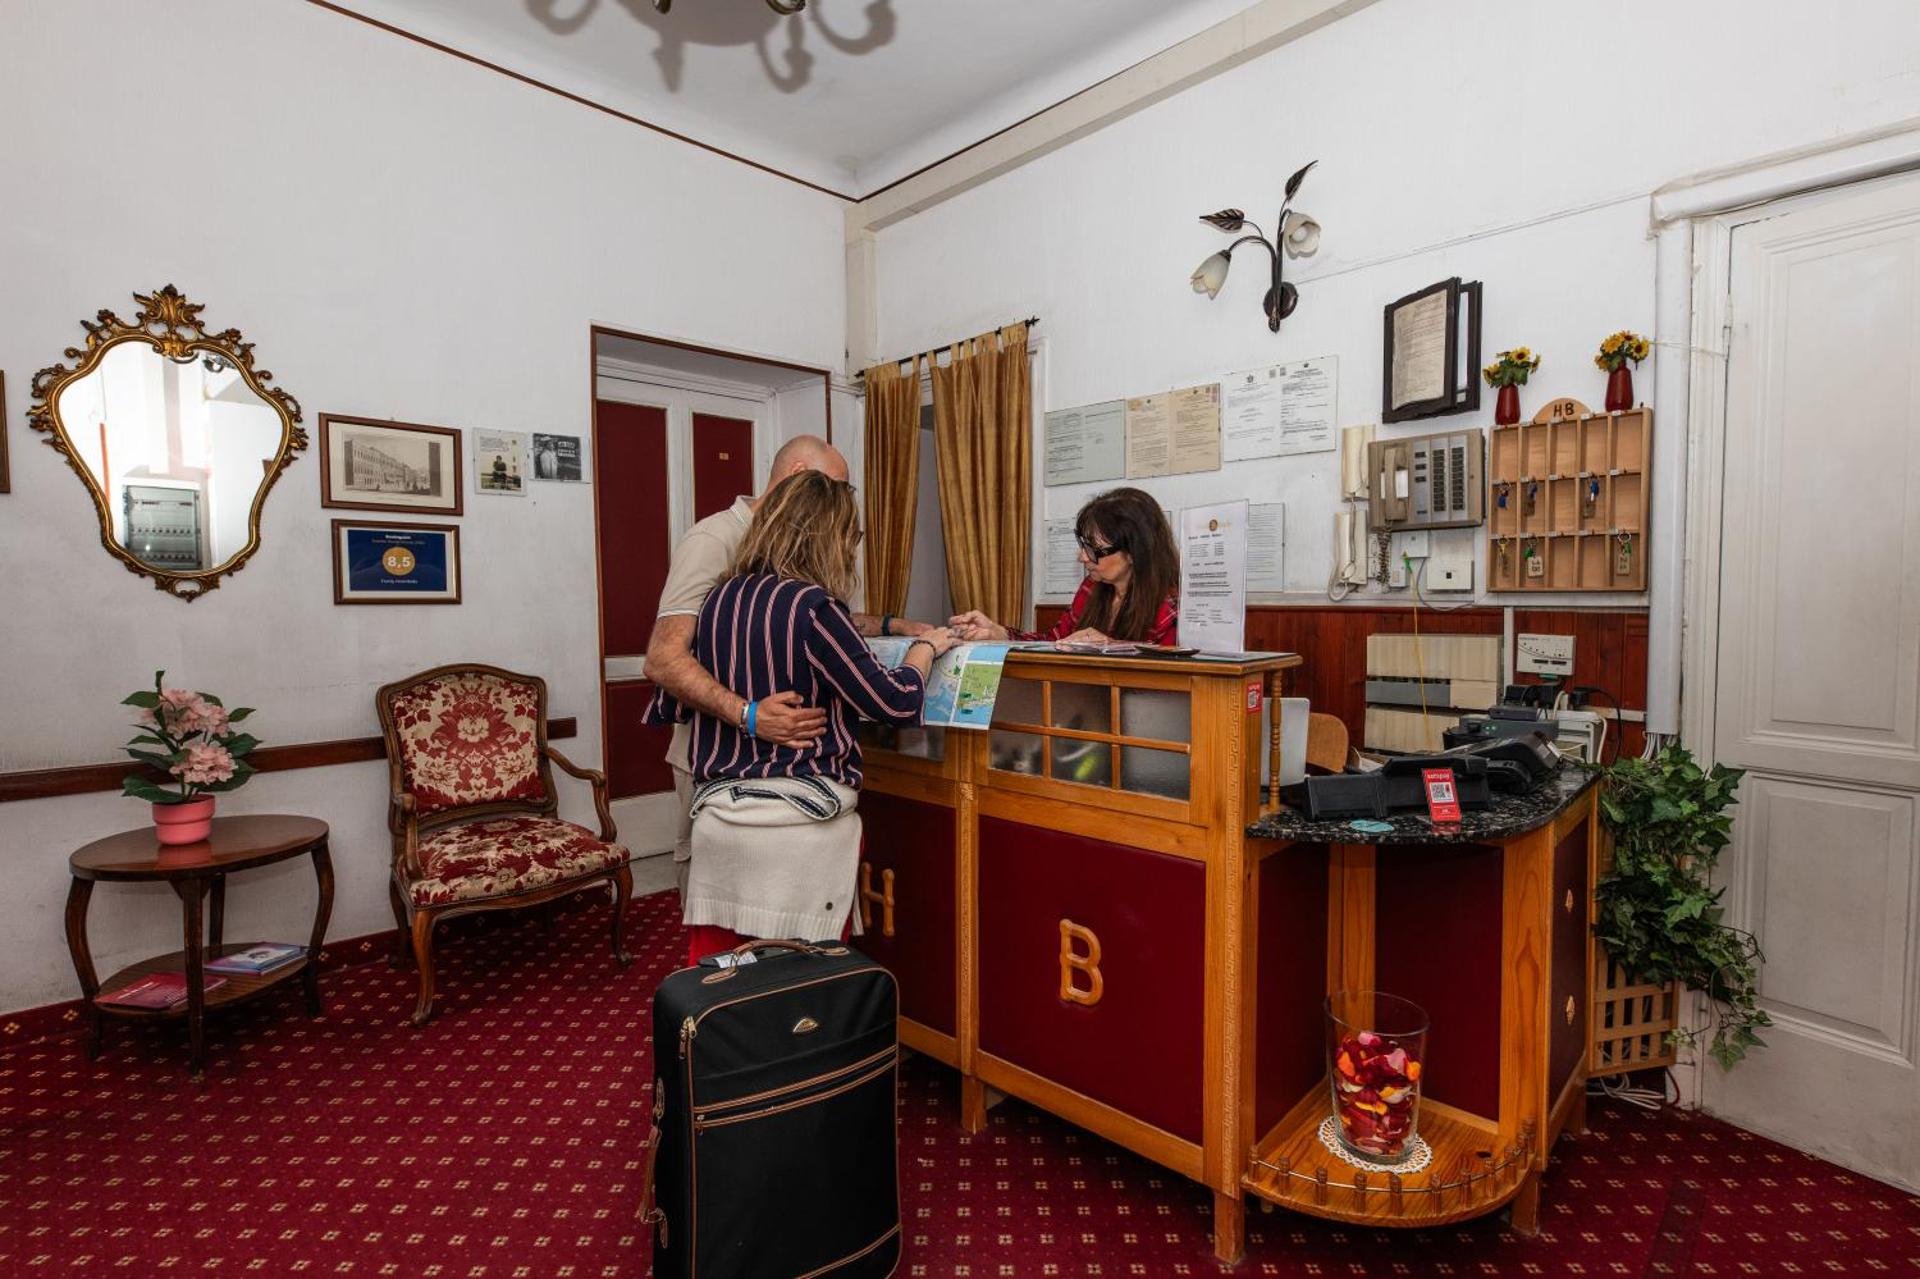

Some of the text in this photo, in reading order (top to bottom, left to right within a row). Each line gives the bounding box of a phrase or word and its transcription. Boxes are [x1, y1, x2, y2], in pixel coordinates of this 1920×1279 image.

[387, 556, 411, 569] 8,5
[860, 861, 895, 937] H
[1059, 918, 1104, 1006] B
